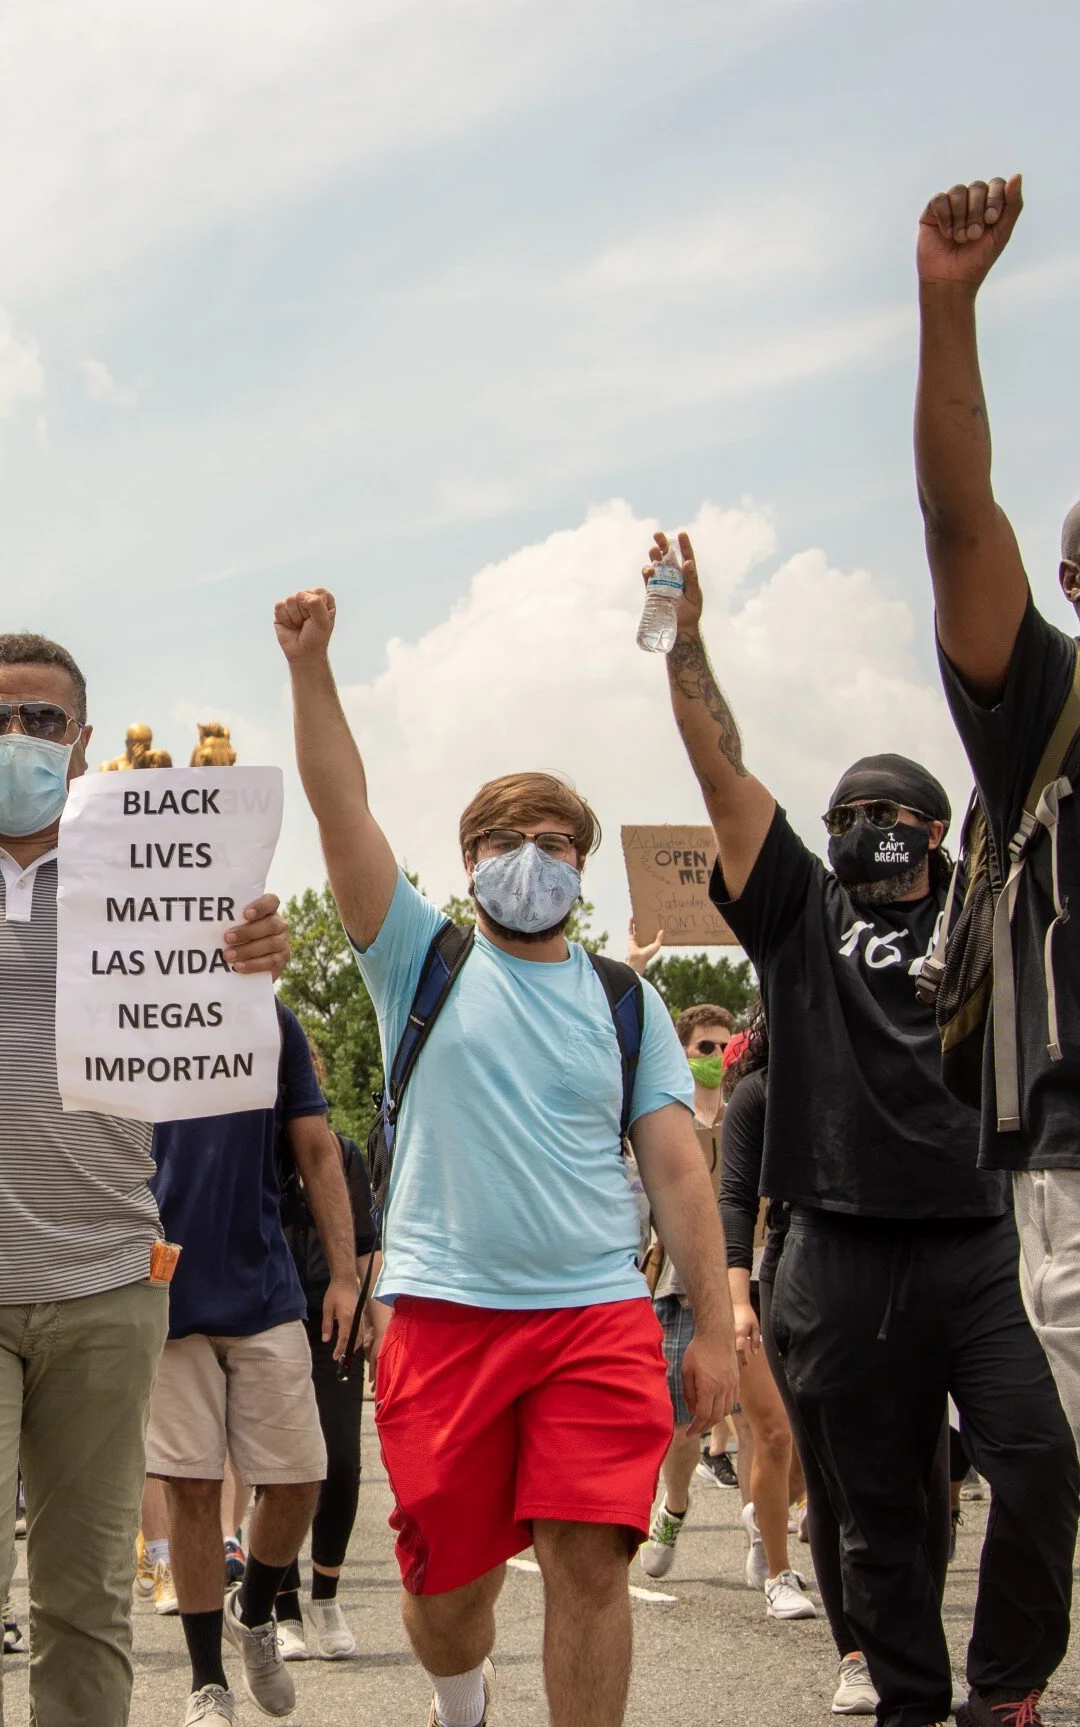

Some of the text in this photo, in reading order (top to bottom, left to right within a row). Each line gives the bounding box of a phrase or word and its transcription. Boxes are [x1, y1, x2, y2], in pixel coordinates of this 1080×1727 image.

[123, 788, 220, 815] BLACK
[879, 841, 905, 851] CAN'T
[887, 832, 895, 841] I
[130, 842, 212, 868] LIVES
[655, 850, 707, 867] OPEN
[874, 852, 909, 863] BREATHE
[106, 896, 235, 922] MATTER
[92, 948, 237, 976] LAS VIDA
[119, 1002, 222, 1029] NEGAS
[85, 1052, 254, 1082] IMPORTAN
